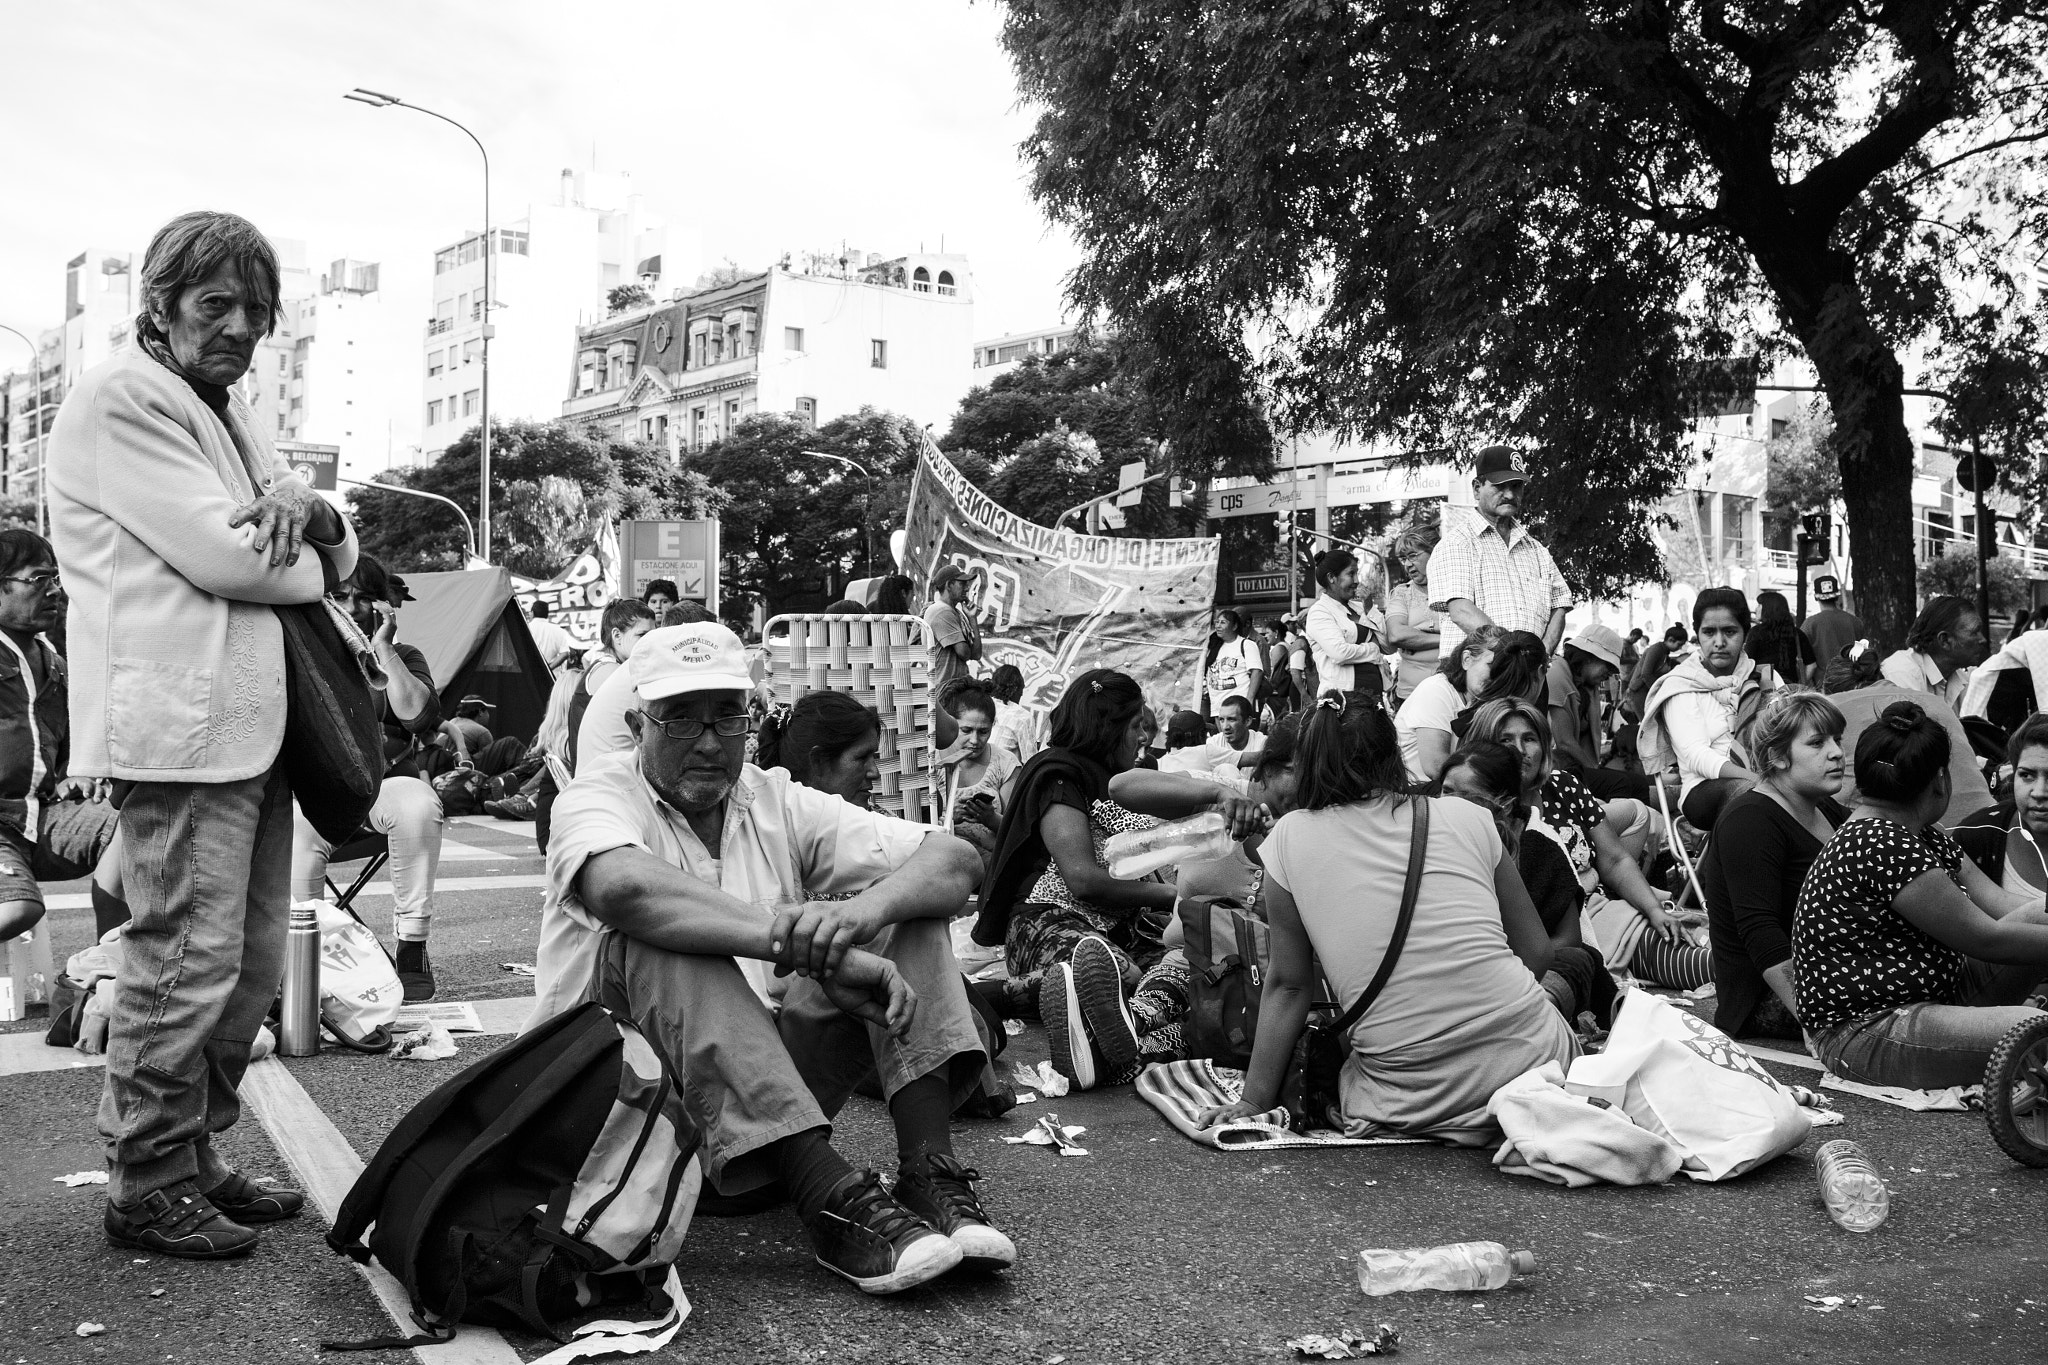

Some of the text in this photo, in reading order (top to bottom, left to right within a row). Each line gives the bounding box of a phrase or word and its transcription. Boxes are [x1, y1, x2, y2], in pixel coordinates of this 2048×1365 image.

[292, 452, 334, 463] BELGRANO
[658, 522, 681, 558] E
[641, 561, 698, 570] ESTACIONE AQUI
[1237, 577, 1286, 592] TOTALINE
[672, 637, 719, 653] MUNICIPALIDAD
[682, 654, 711, 663] MERLO
